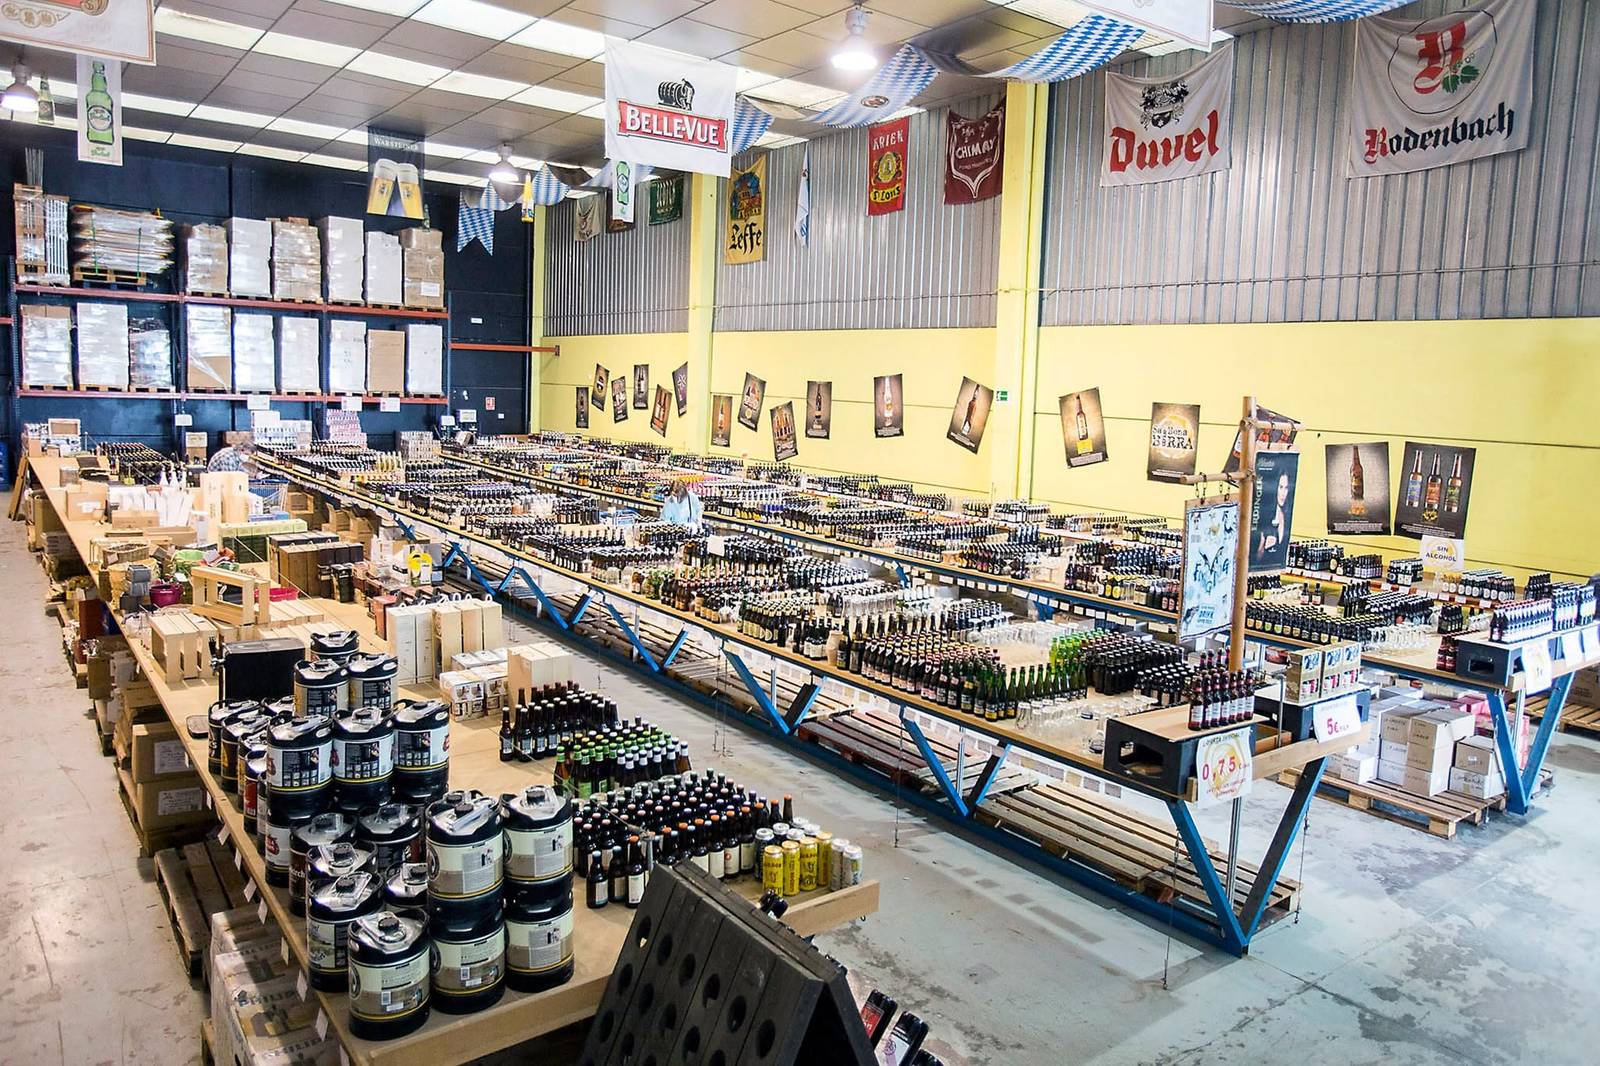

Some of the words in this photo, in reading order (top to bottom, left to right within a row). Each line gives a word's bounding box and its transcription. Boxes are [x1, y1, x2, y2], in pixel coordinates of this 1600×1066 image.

[626, 105, 720, 145] BELLE-VUE
[1110, 109, 1220, 172] Duvel
[1363, 101, 1515, 165] Rodenbach
[955, 136, 997, 159] CHIMAY
[729, 221, 762, 256] Leffe
[1425, 551, 1457, 562] ALCOHOL
[1437, 545, 1449, 553] SIN
